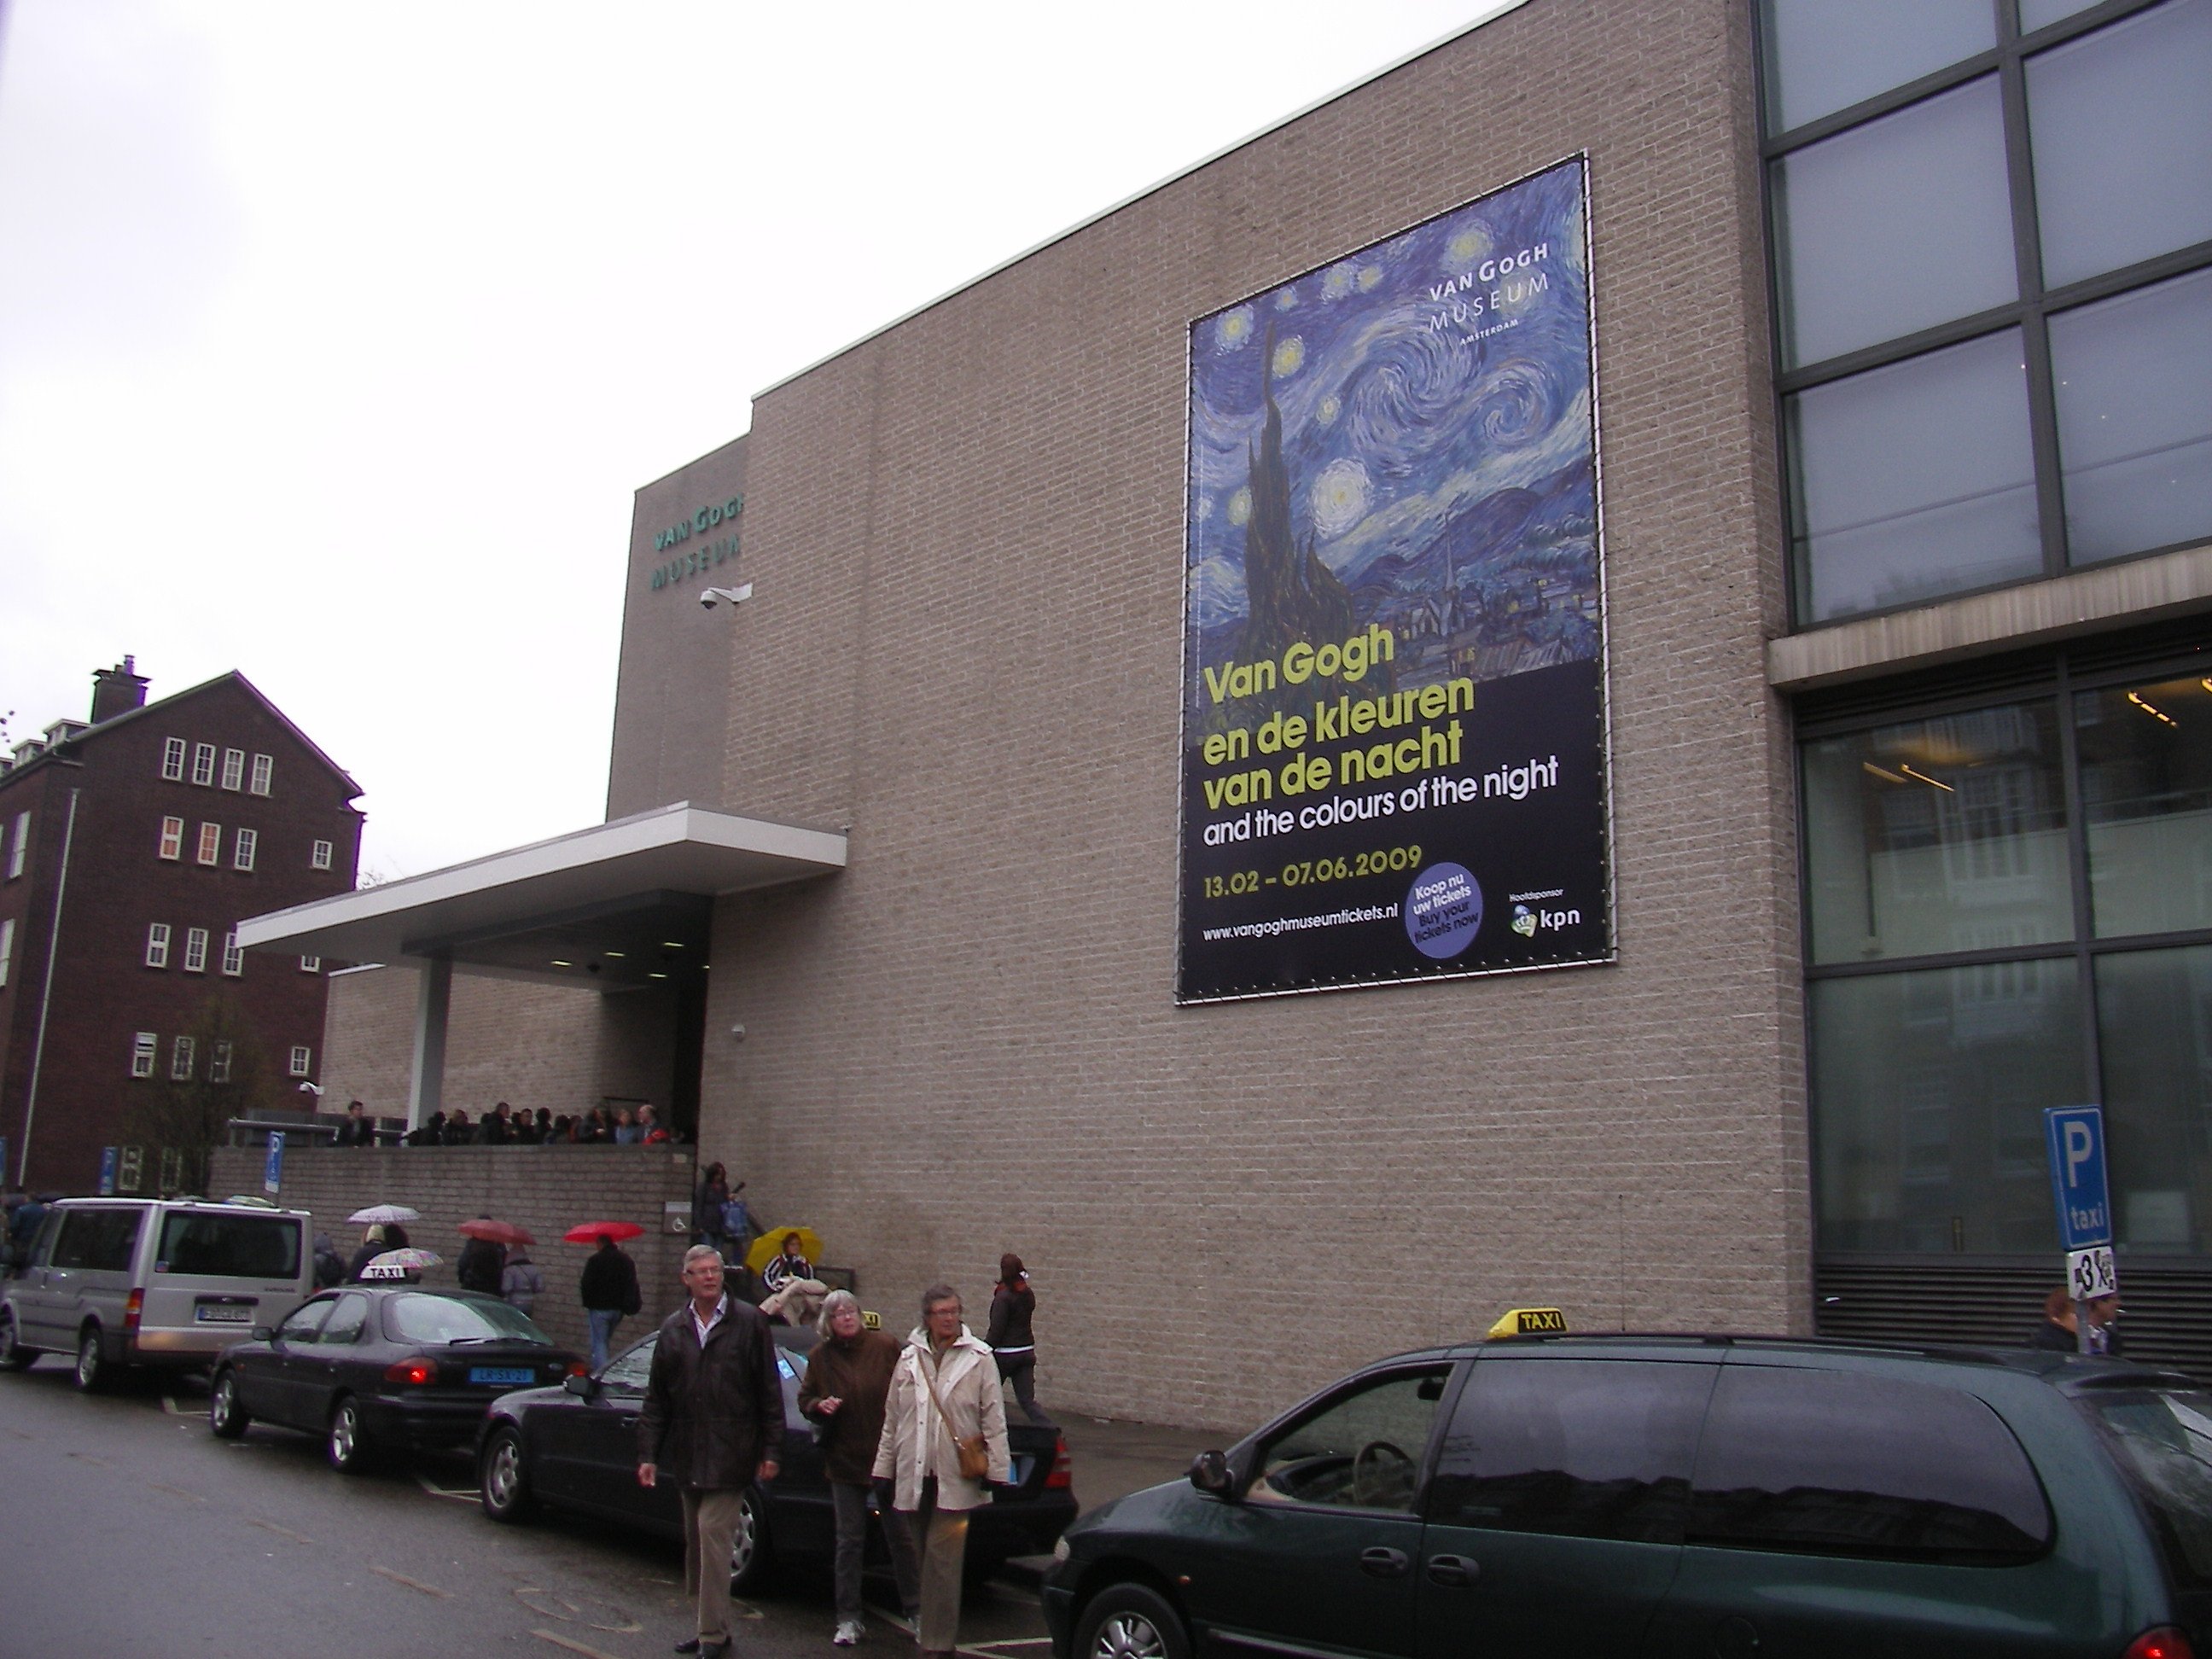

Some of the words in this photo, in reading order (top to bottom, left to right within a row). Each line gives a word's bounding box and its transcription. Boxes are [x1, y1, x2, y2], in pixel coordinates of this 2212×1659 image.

[1429, 272, 1473, 301] VAN
[1478, 242, 1548, 282] GOGH
[1429, 272, 1549, 333] MUSEUM
[1459, 318, 1519, 346] AMSTERDAM
[654, 520, 690, 552] VAN
[1203, 659, 1277, 704] Van
[1282, 622, 1394, 684] Gogh
[1202, 726, 1250, 766] en
[1256, 710, 1308, 754] de
[1314, 676, 1475, 743] kleuren
[1202, 768, 1272, 810] van
[1280, 752, 1333, 796] de
[1340, 719, 1464, 786] nacht
[1202, 812, 1251, 847] and
[1254, 808, 1295, 837] the
[1299, 790, 1396, 830] colours
[1399, 781, 1429, 812] of
[1430, 775, 1477, 807] the
[1483, 754, 1559, 800] night
[1203, 870, 1260, 898] 13.02
[1282, 844, 1423, 887] 07.06.2009
[1415, 881, 1447, 900] Koop
[1447, 873, 1465, 888] nu
[1412, 900, 1431, 915] uw
[1432, 885, 1472, 908] tickets
[1418, 911, 1441, 927] Buy
[1442, 901, 1470, 920] your
[1202, 902, 1399, 941] www.vangoghmuseumtickets.nl
[1414, 922, 1452, 943] tickets
[1453, 912, 1479, 929] now
[1540, 909, 1581, 932] kpn
[2064, 1121, 2093, 1187] P
[2070, 1201, 2105, 1231] taxi
[370, 1267, 400, 1279] TAXI
[1520, 1313, 1562, 1330] TAXI
